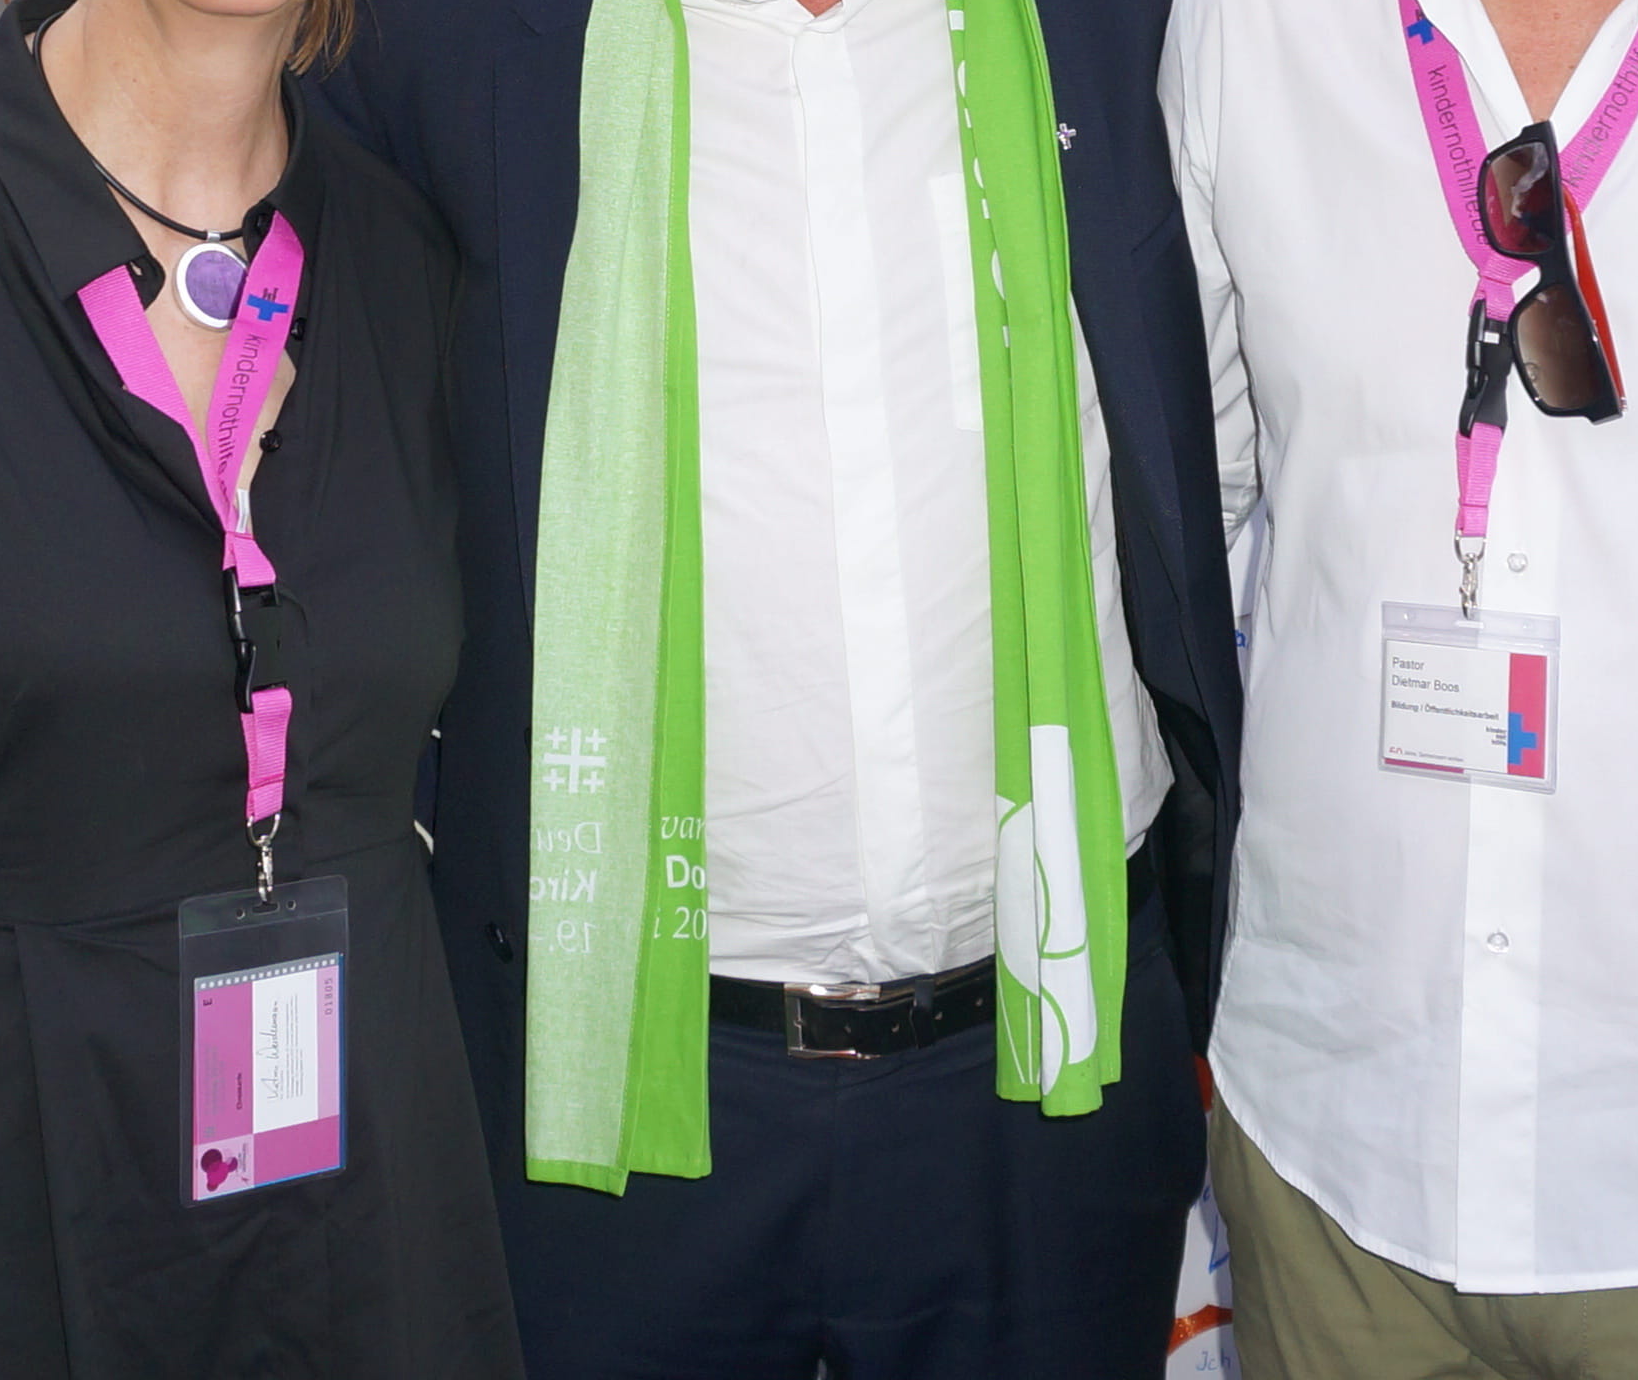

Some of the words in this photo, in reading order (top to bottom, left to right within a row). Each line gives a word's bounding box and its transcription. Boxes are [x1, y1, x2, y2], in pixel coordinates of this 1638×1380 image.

[1392, 656, 1425, 671] Pastor
[1391, 675, 1431, 690] Dietmar
[1433, 680, 1460, 693] Boos
[665, 854, 705, 890] Do
